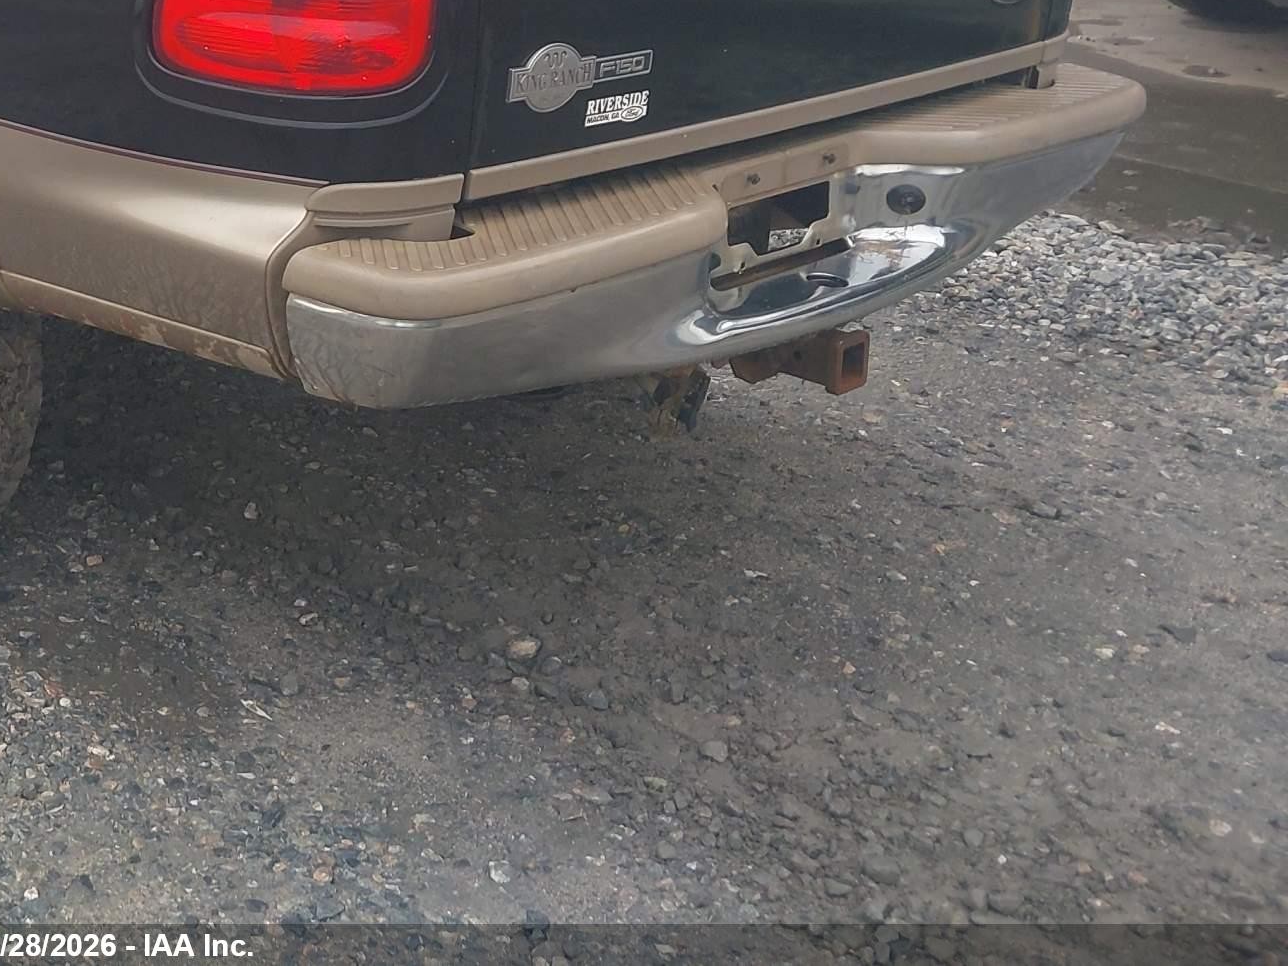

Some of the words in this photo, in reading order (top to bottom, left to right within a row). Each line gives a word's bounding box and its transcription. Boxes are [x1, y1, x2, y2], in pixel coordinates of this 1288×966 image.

[516, 72, 547, 92] KING
[552, 63, 592, 87] RANCH
[587, 90, 649, 115] RIVERSIDE
